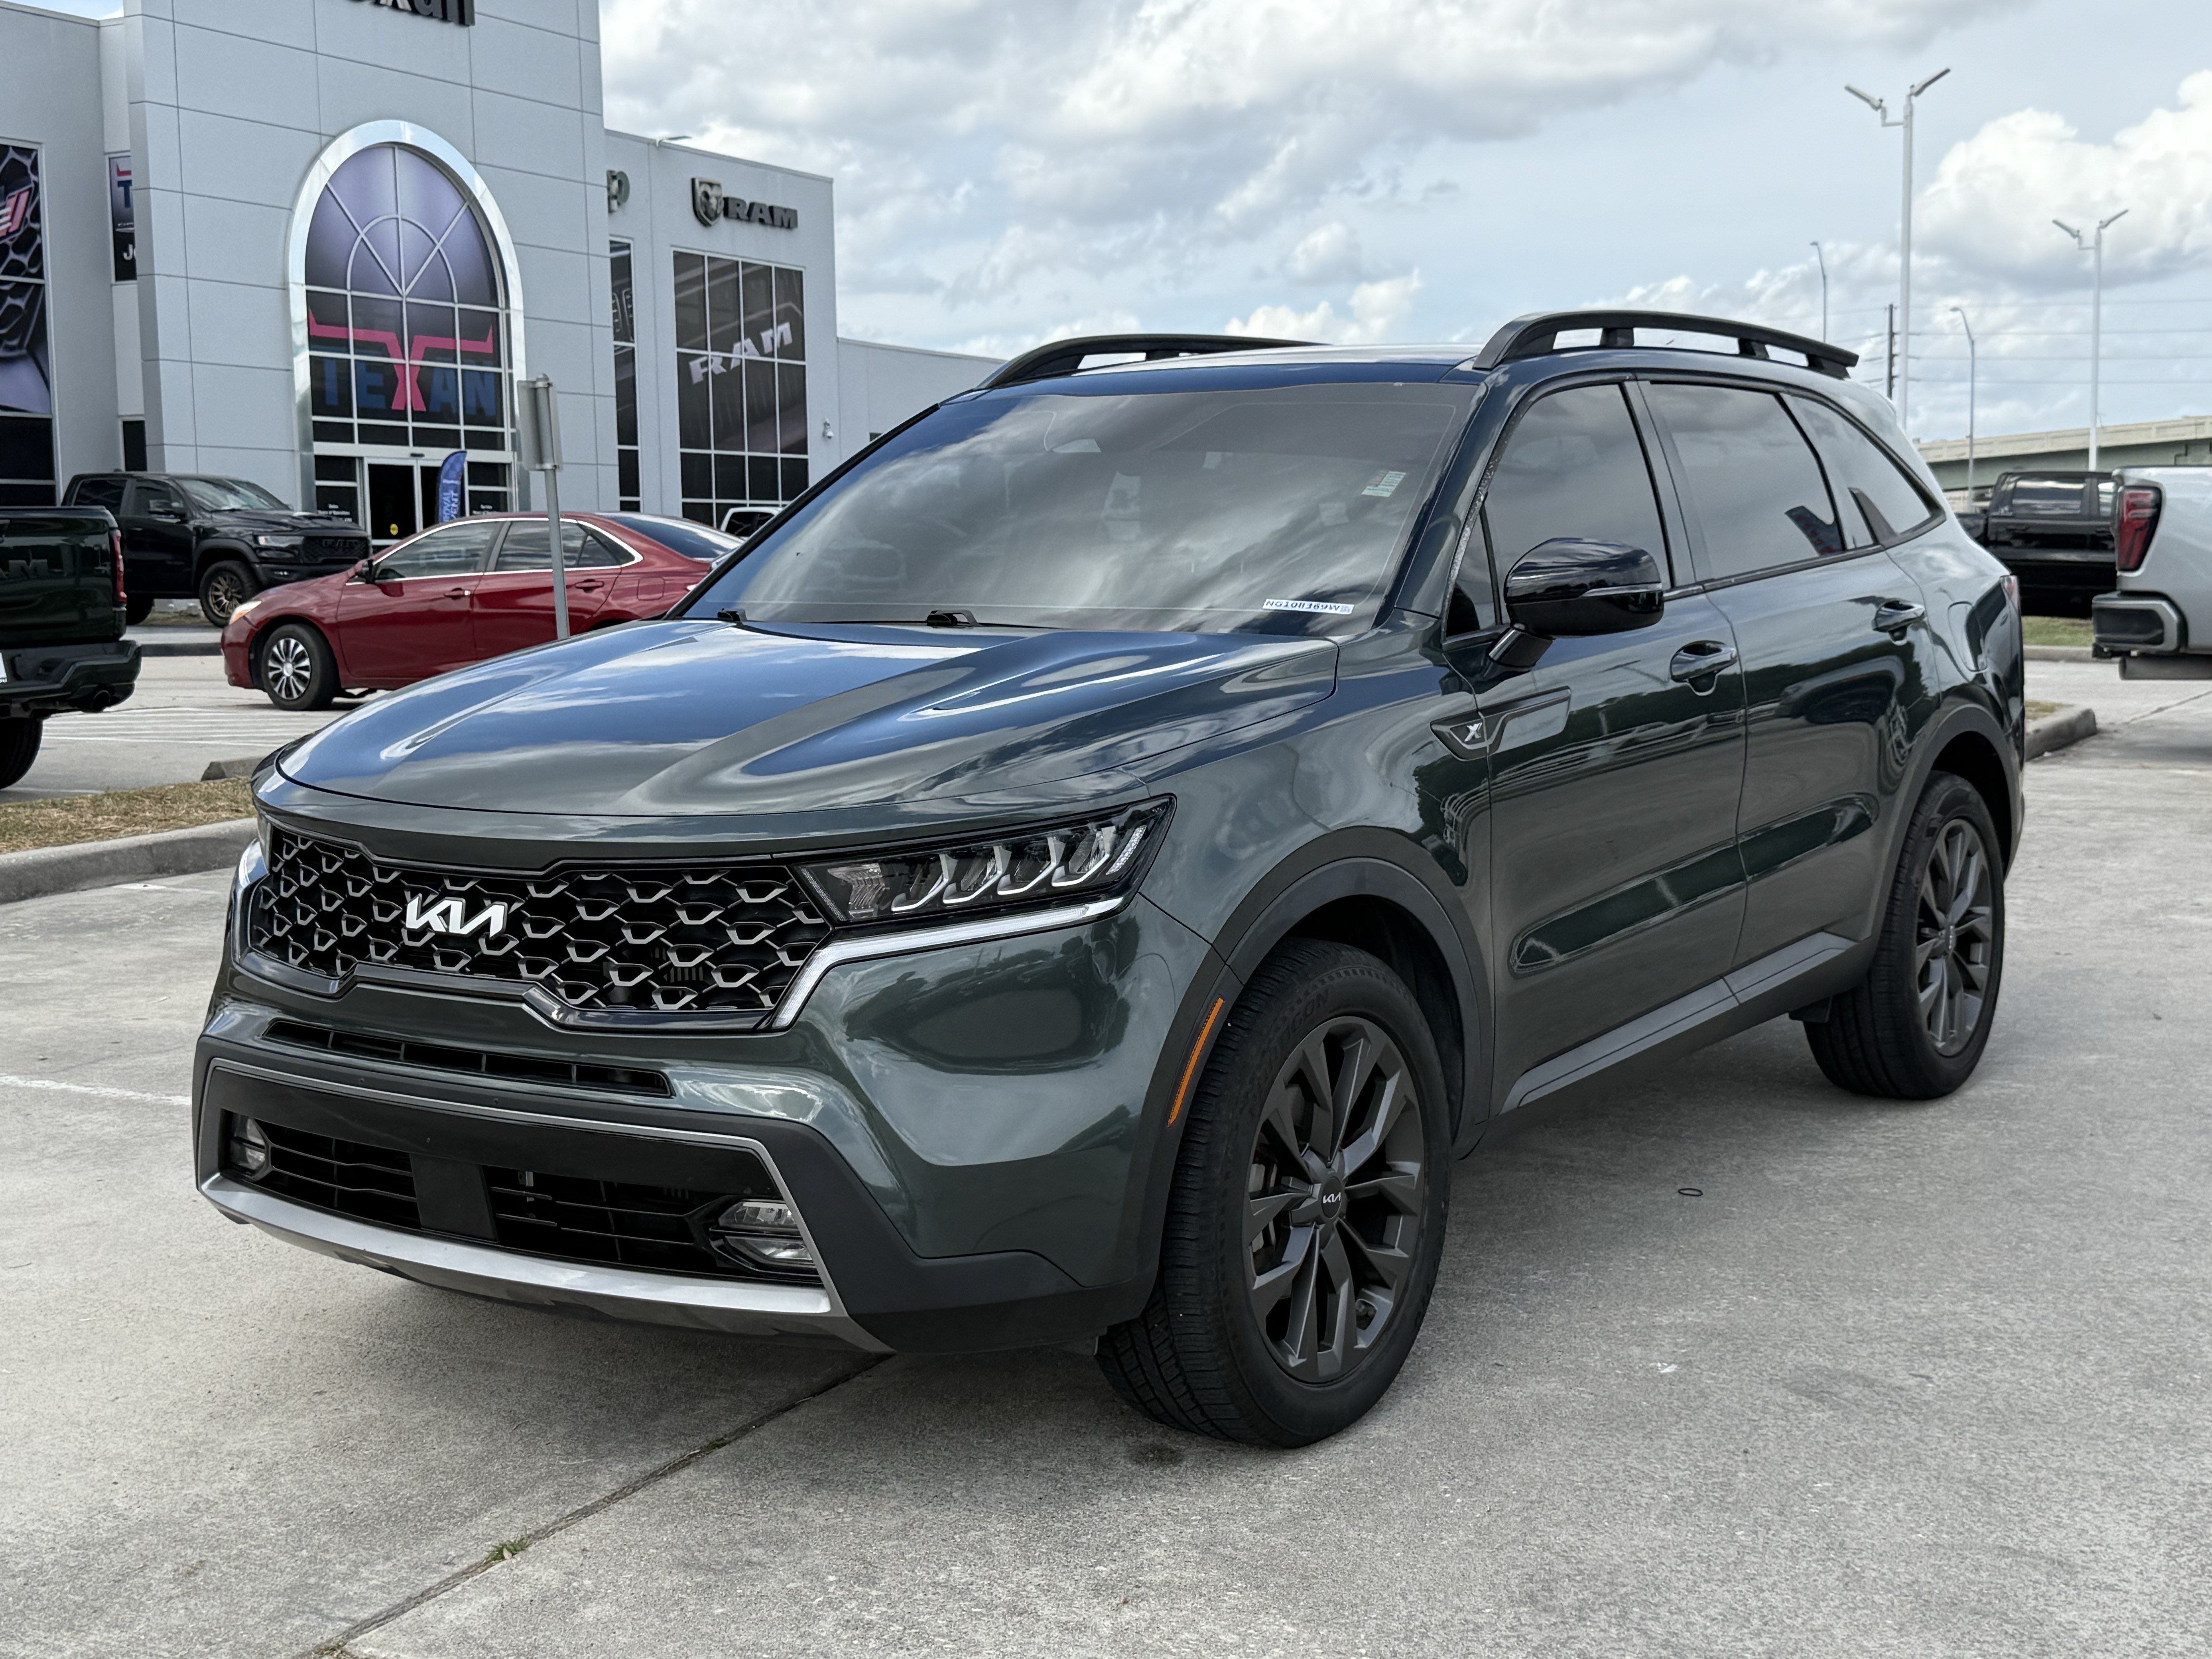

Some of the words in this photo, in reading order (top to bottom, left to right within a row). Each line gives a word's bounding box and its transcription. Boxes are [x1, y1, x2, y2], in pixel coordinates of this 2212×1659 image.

[723, 197, 798, 229] RAM
[309, 310, 496, 416] TEXAN
[689, 322, 793, 385] RAM
[405, 893, 508, 940] KIA
[1322, 1192, 1341, 1204] KIA
